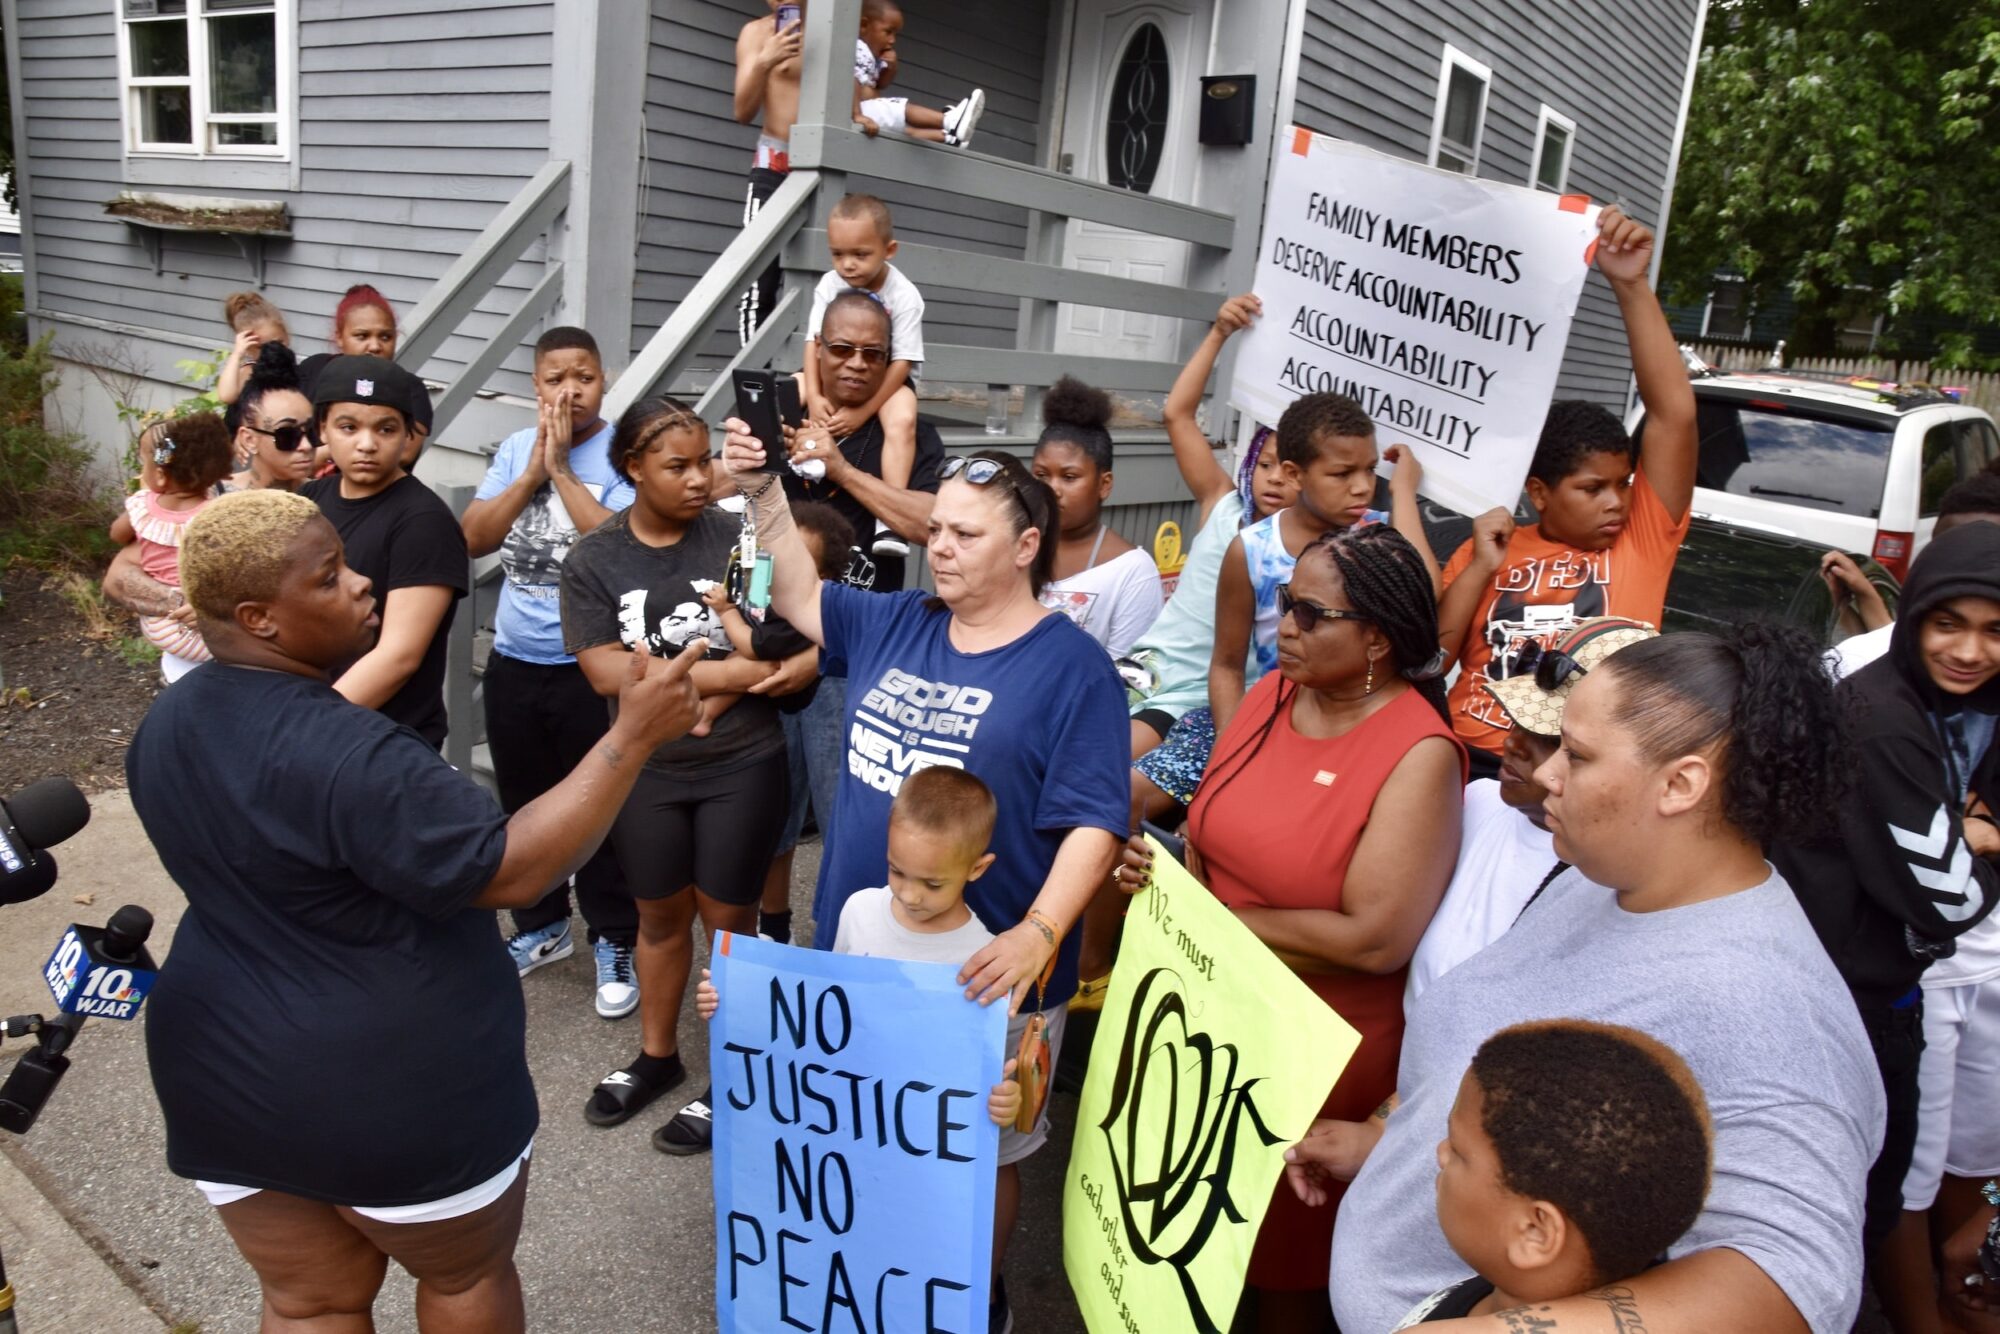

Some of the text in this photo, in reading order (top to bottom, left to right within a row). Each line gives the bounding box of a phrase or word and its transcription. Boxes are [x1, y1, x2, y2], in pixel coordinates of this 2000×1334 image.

[1307, 192, 1523, 284] FAMILY MEMBERS
[1273, 237, 1546, 351] DESERVE ACCOUNTABILITY
[1291, 306, 1498, 397] ACCOUNTABILITY
[1280, 357, 1482, 451] ACCOUNTABILITY
[861, 689, 979, 739] ENOUGH
[878, 668, 993, 715] GOOD
[902, 730, 920, 746] IS
[54, 931, 83, 977] 10
[1149, 880, 1216, 982] We must
[46, 961, 69, 1004] WJAR
[75, 997, 132, 1018] WJAR
[83, 967, 133, 1000] 10
[770, 976, 851, 1055] NO
[723, 1042, 978, 1163] JUSTICE
[774, 1137, 854, 1235] NO
[1081, 1174, 1128, 1268] each other
[728, 1210, 972, 1334] PEACE
[1101, 1263, 1123, 1304] and
